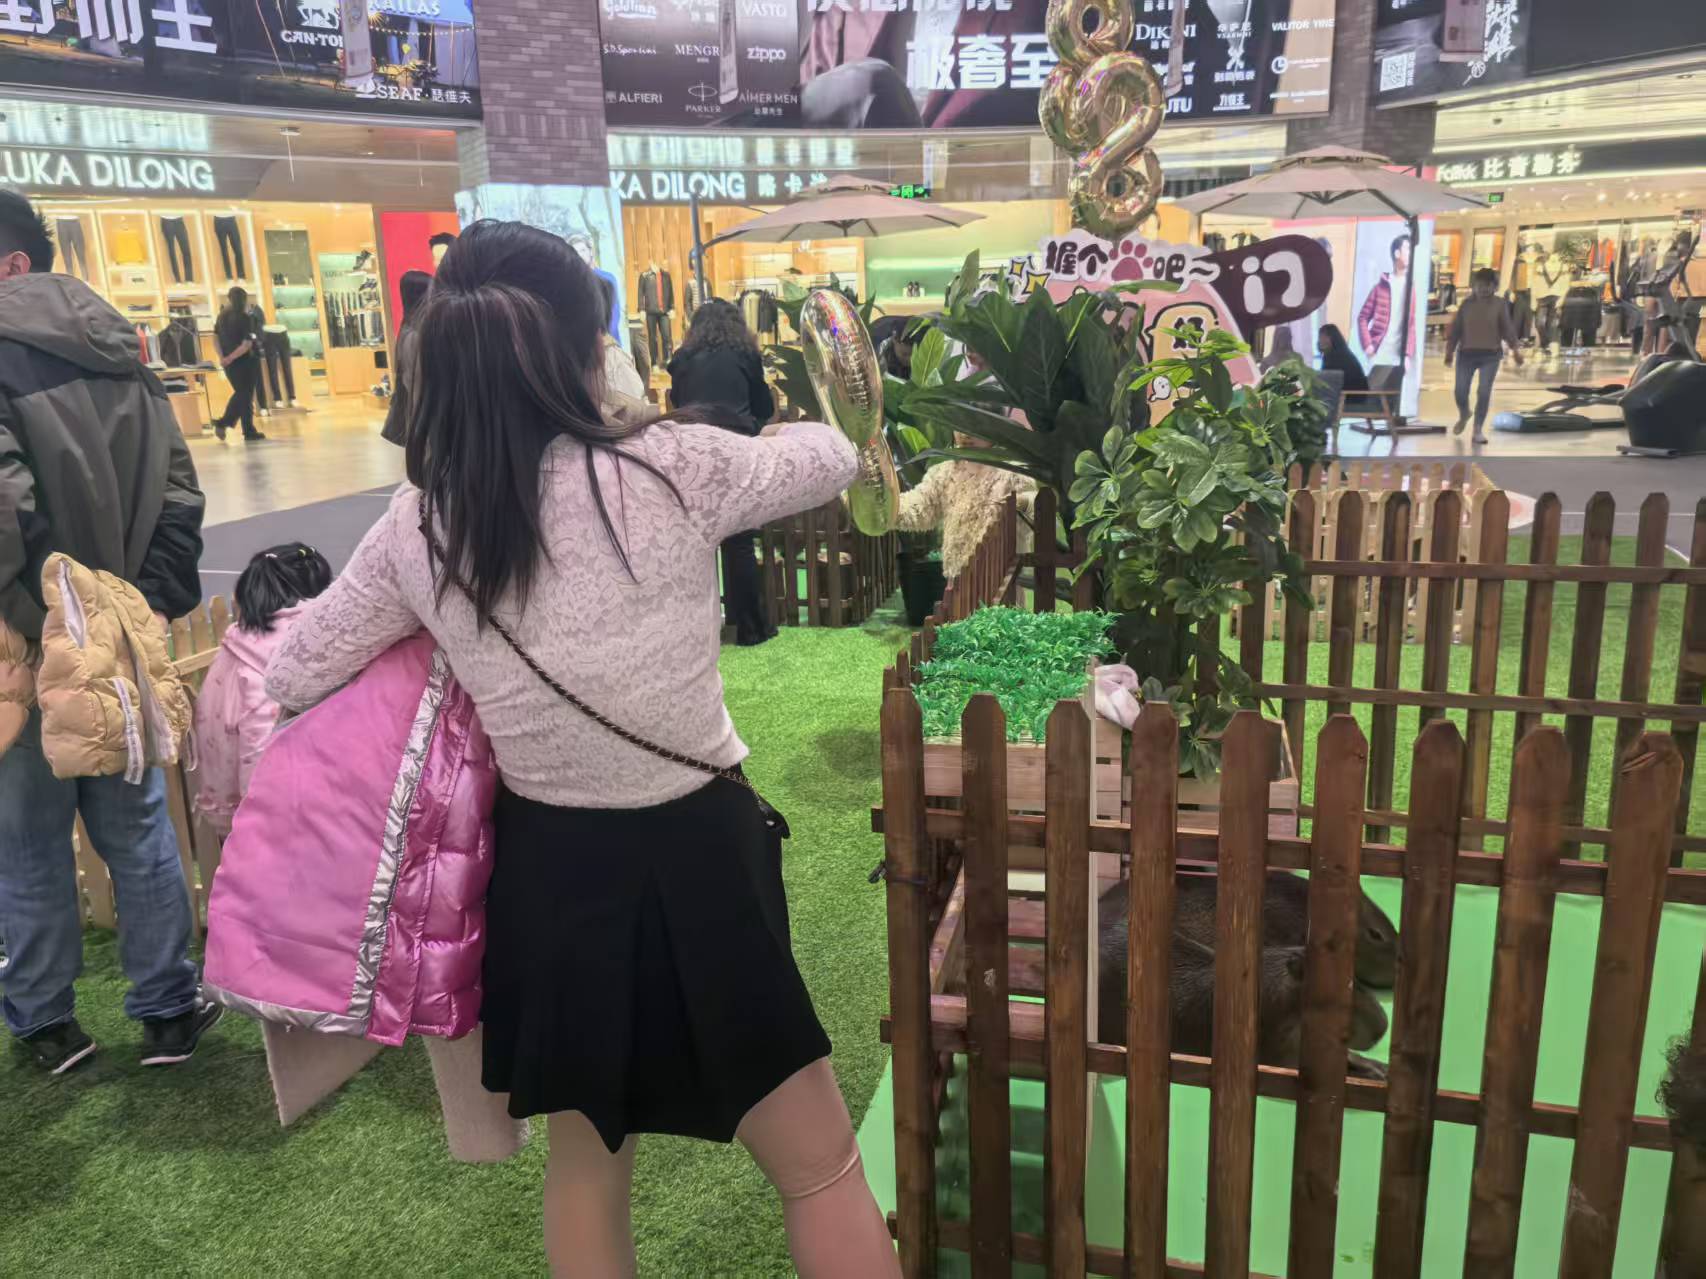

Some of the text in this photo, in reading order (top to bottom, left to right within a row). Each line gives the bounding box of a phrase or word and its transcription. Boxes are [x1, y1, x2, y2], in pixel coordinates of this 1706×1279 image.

[747, 46, 787, 63] zippo
[618, 92, 663, 104] ALFIERI
[685, 104, 721, 113] PARKER
[87, 154, 215, 191] DILONG
[652, 171, 746, 199] DILONG
